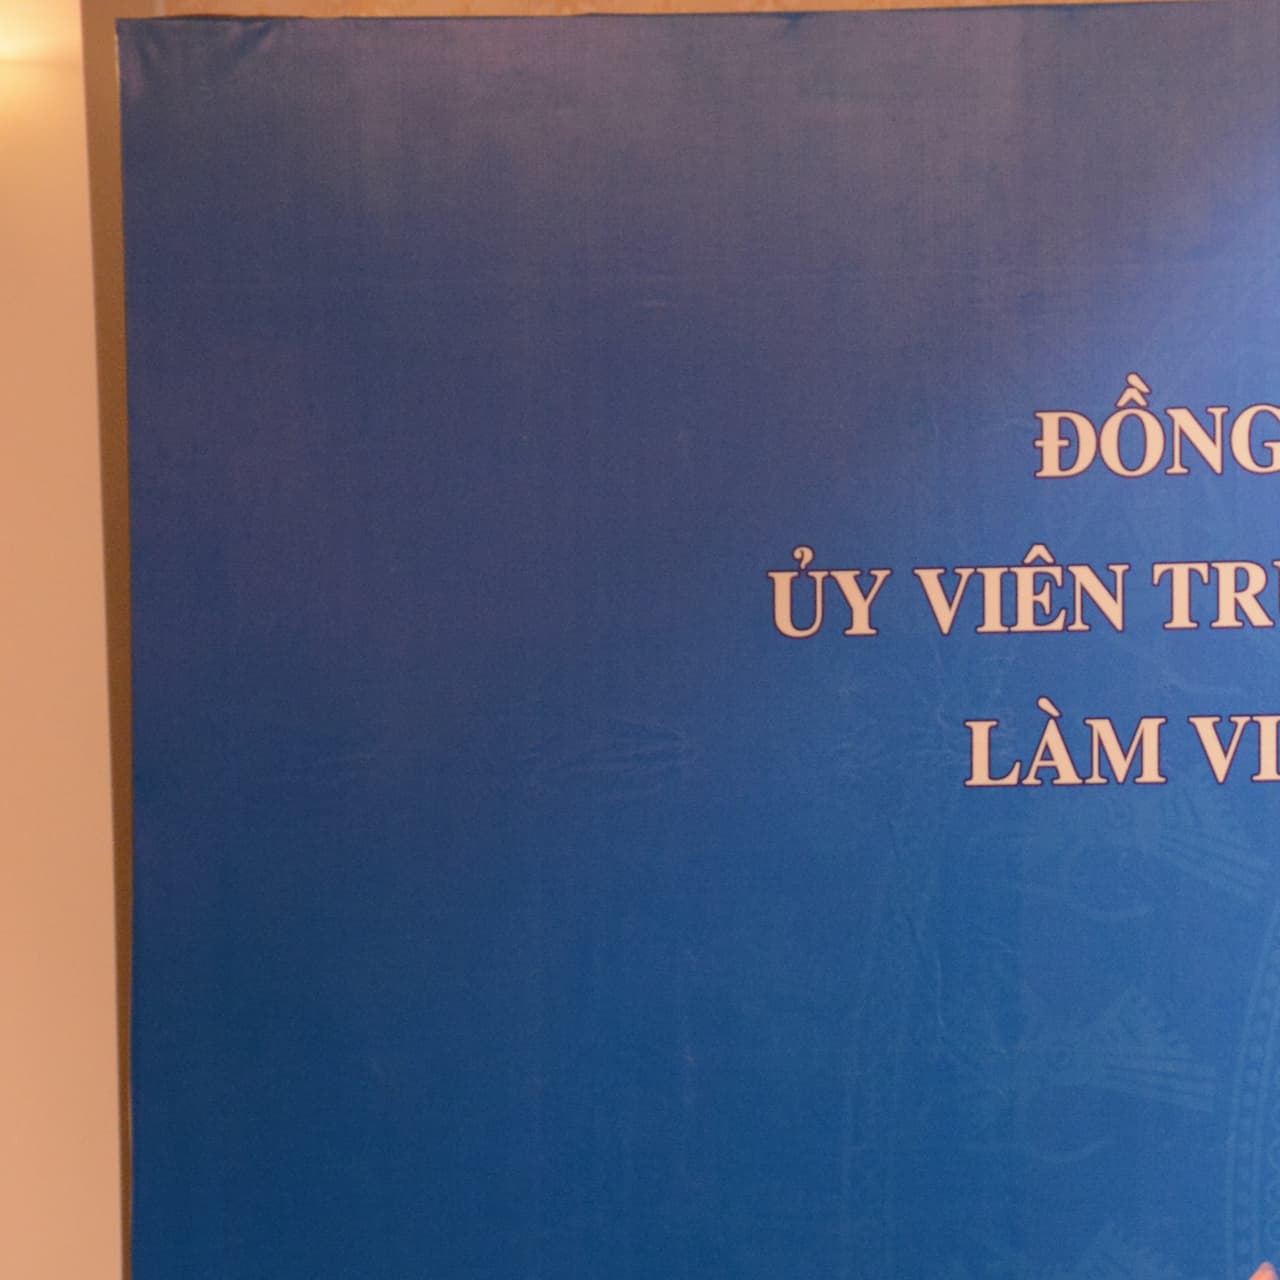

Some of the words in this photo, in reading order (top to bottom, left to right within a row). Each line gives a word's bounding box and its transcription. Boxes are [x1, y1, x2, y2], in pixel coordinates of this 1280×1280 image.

[767, 545, 892, 639] ỦY
[913, 543, 1131, 636] VIÊN
[964, 696, 1167, 787] LÀM
